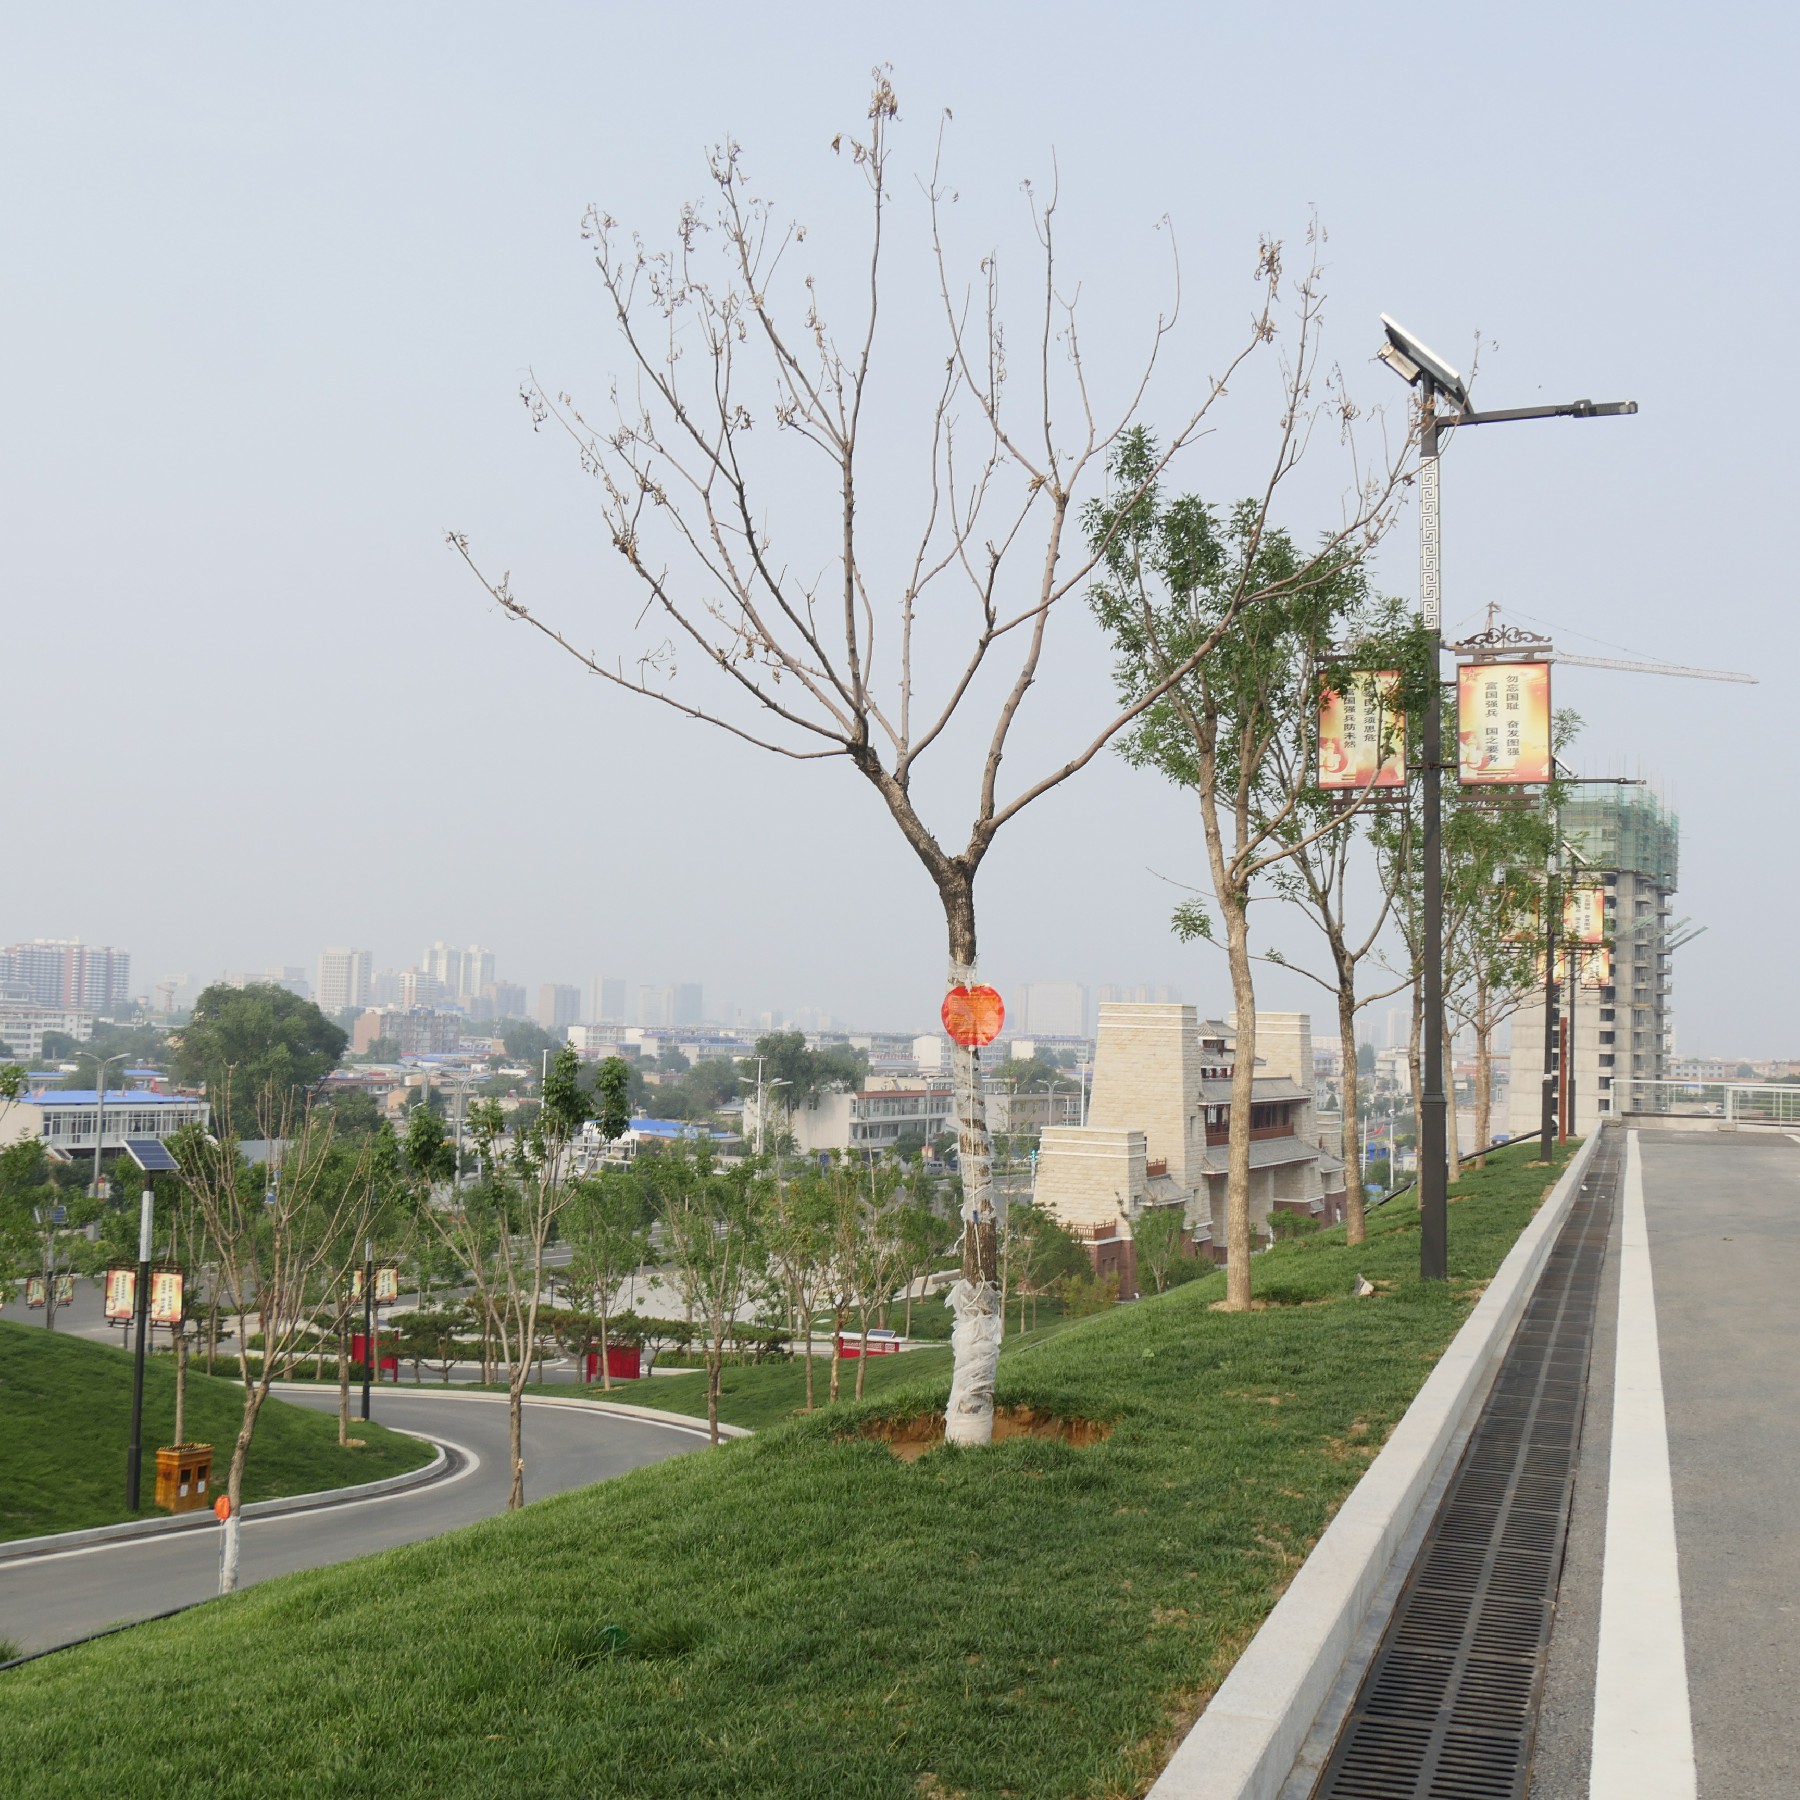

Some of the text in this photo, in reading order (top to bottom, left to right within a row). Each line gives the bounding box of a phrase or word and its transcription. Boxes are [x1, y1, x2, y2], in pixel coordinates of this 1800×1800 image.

[1343, 687, 1356, 749] 富国强兵防未然
[1363, 682, 1377, 742] 泰民安须思危
[1484, 681, 1499, 763] 富国强兵 国之要务
[1506, 675, 1520, 756] 勿忘国耻 奋发图强
